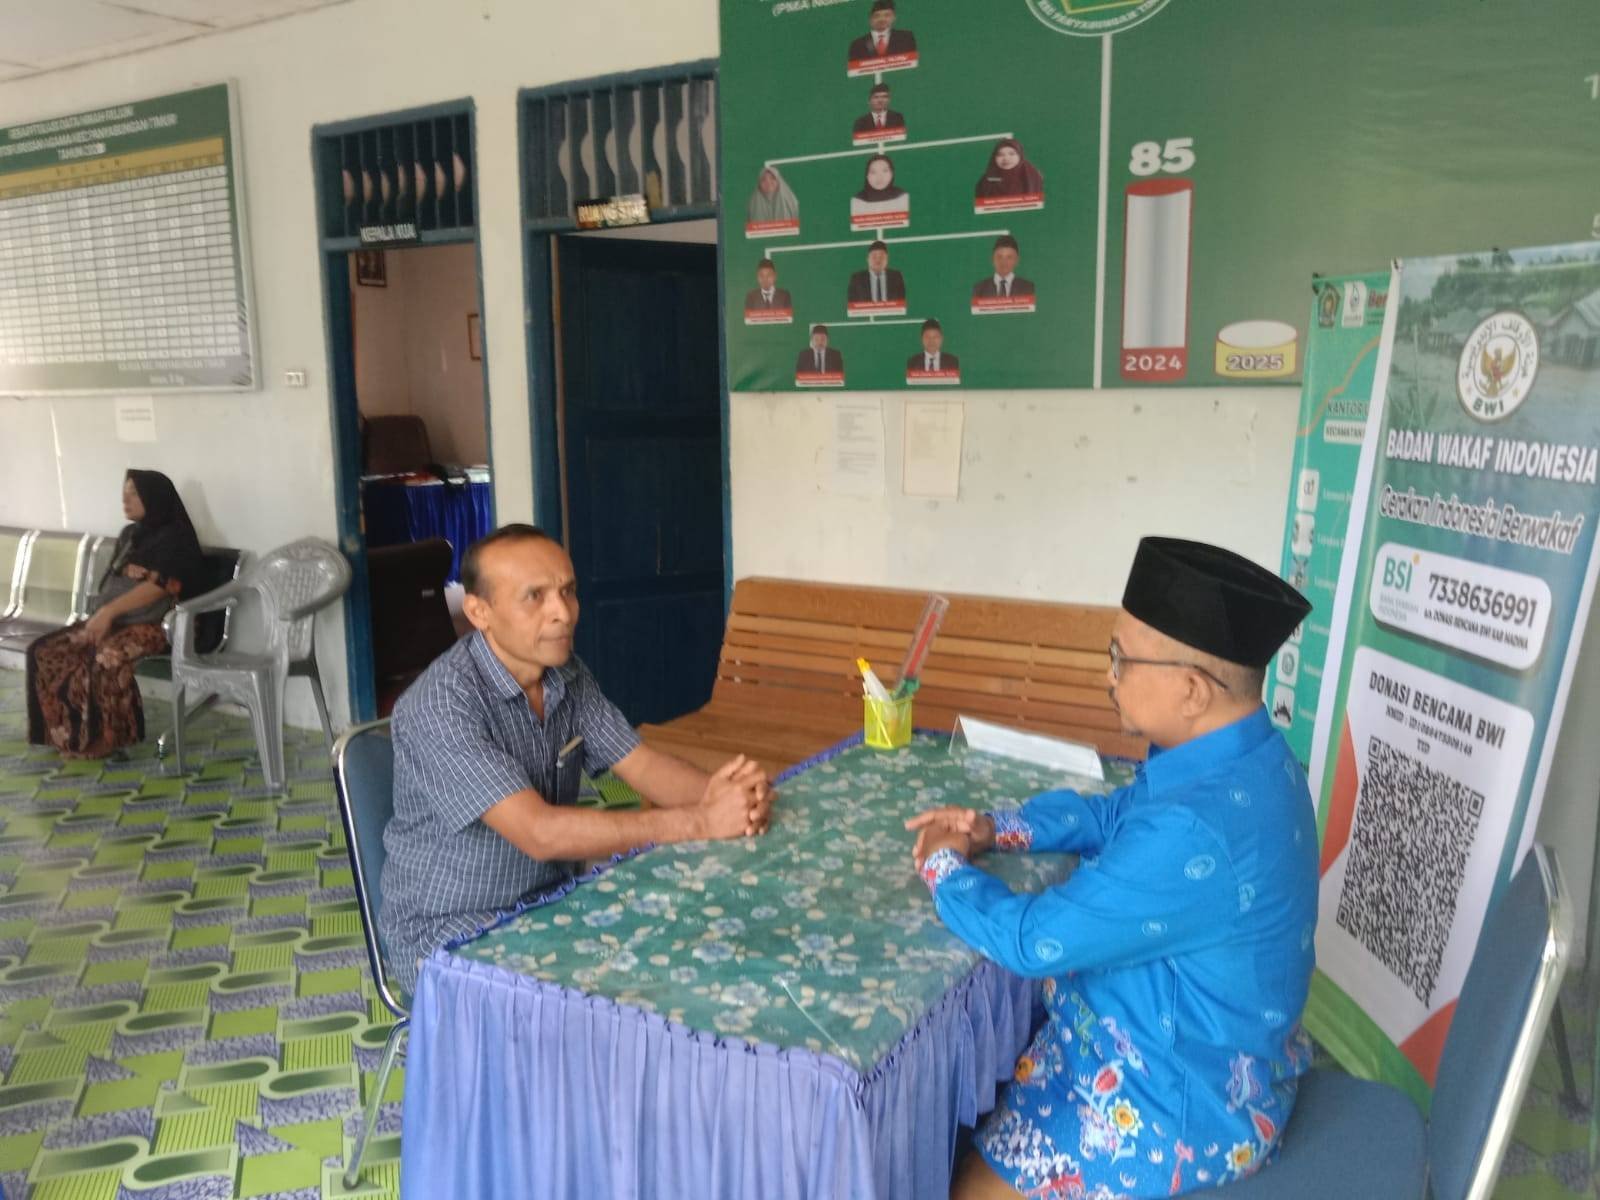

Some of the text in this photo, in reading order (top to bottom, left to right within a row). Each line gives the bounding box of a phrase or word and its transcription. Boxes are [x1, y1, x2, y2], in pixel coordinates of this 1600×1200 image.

[1129, 137, 1196, 176] 85
[1124, 355, 1182, 371] 2024
[1225, 354, 1284, 371] 2025
[1472, 397, 1505, 417] BWI
[1385, 429, 1598, 484] BADAN WAKAF INDONESIA
[1379, 484, 1585, 555] Gerakan Indonesia Berwakaf
[1382, 557, 1414, 593] BSI
[1428, 571, 1538, 629] 7338636991
[1368, 671, 1506, 750] DONASI BENCANA BWI
